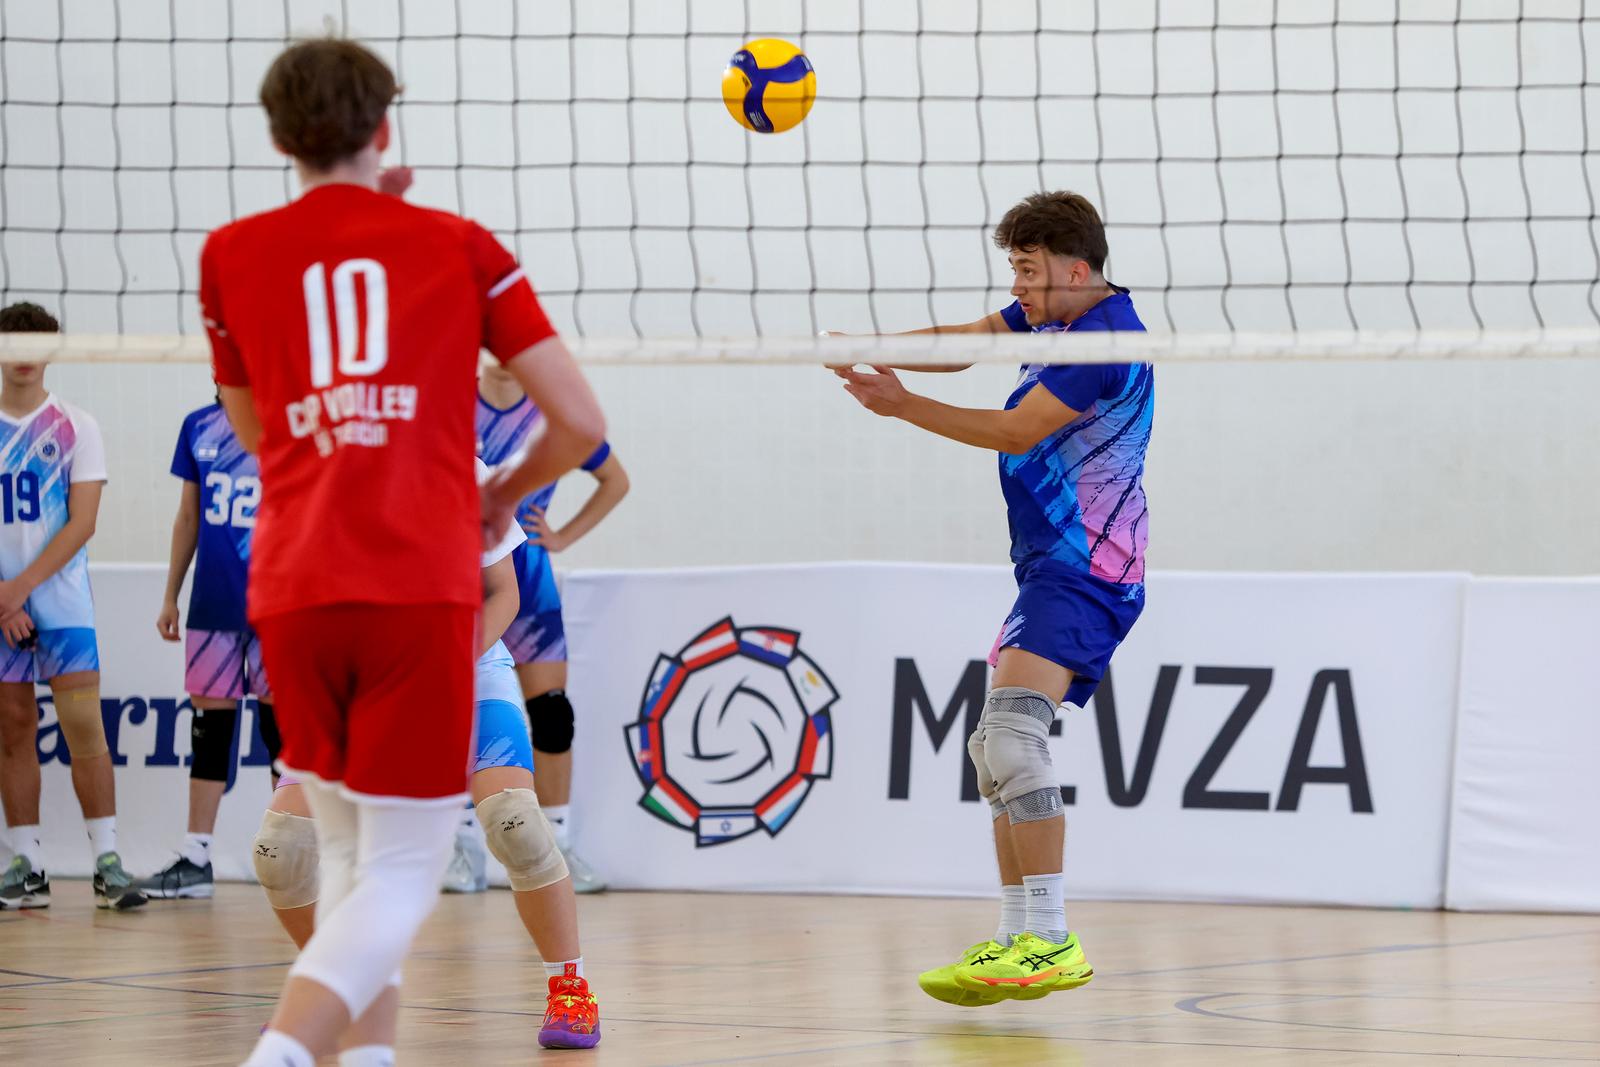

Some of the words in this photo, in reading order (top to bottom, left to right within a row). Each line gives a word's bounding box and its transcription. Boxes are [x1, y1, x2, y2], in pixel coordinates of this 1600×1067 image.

[303, 258, 389, 387] 10
[322, 382, 418, 420] VOLLEY
[0, 470, 41, 524] 19
[205, 472, 262, 528] 32
[888, 657, 1375, 814] MVZA
